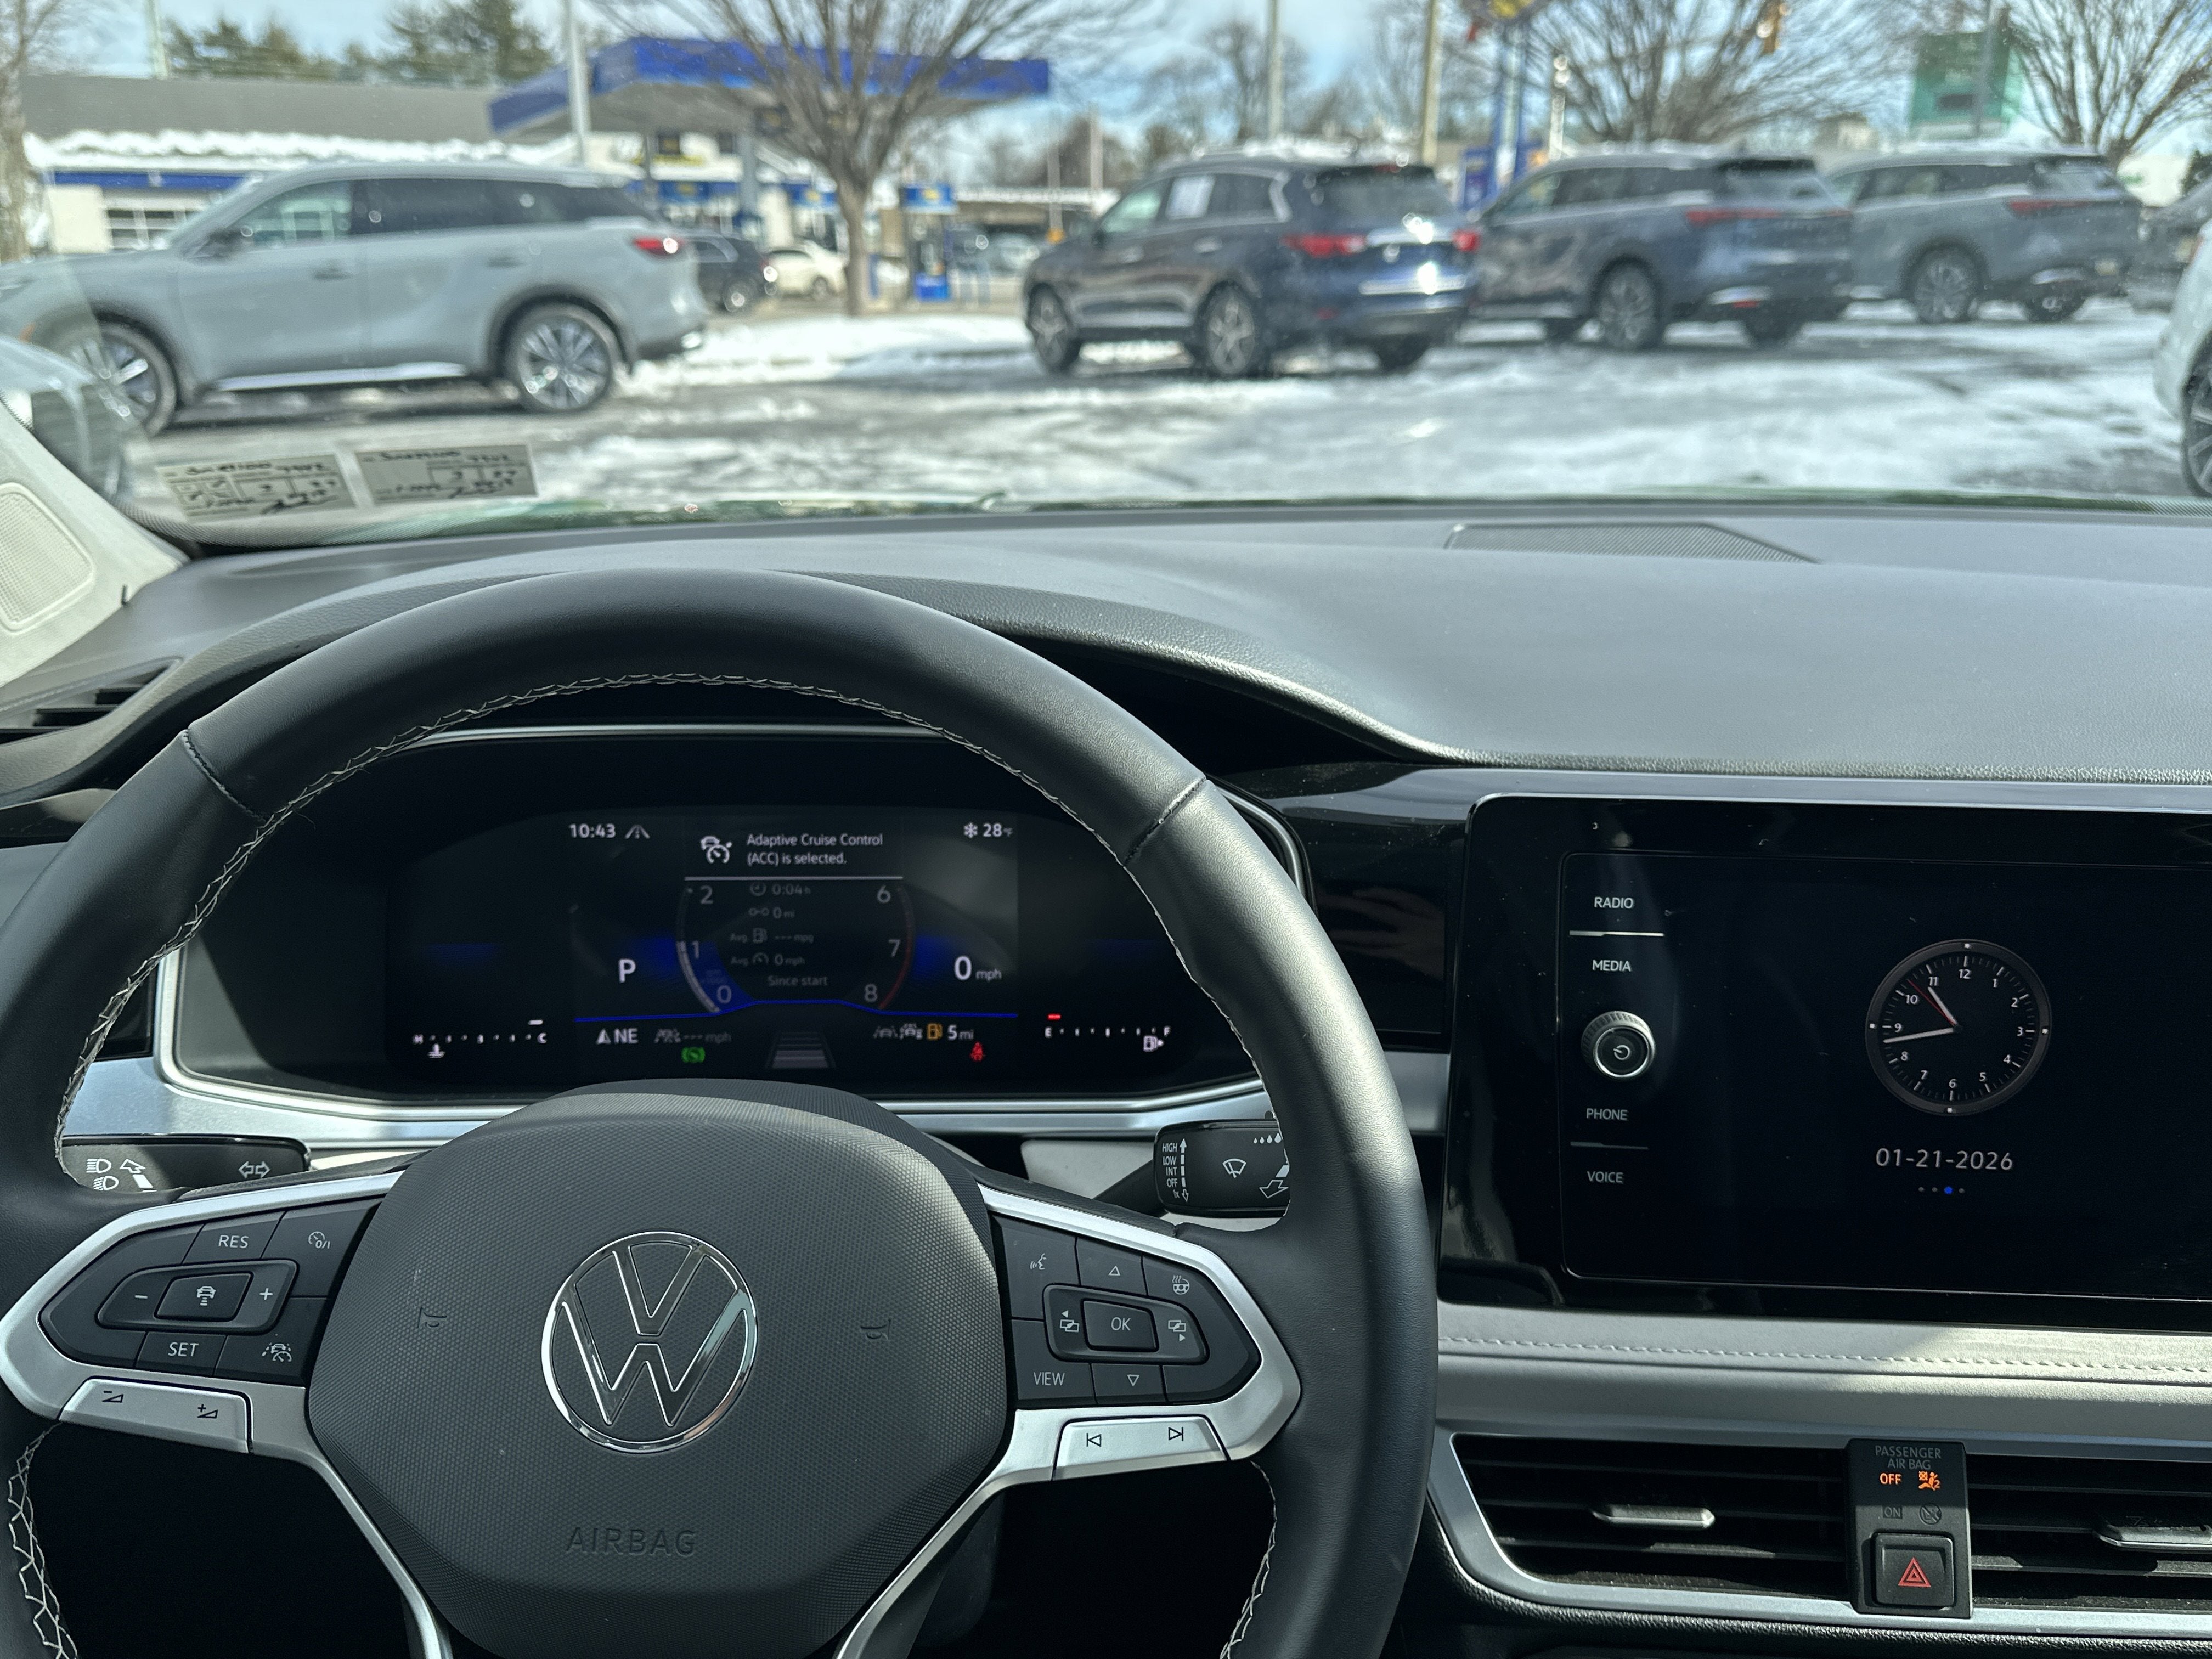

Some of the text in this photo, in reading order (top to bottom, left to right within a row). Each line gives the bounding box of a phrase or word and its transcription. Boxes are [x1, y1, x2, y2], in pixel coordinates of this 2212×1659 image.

[569, 823, 616, 838] 10:43
[747, 833, 883, 848] Adaptive Cruise Control
[747, 852, 847, 866] (ACC) is selected.
[700, 885, 713, 904] 2
[772, 884, 803, 895] 0:04
[877, 885, 891, 904] 6
[1594, 896, 1634, 909] RADIO
[772, 907, 782, 918] 0
[691, 940, 700, 959] 1
[888, 939, 901, 957] 7
[774, 953, 783, 966] 0
[1592, 960, 1632, 972] MEDIA
[619, 958, 636, 983] P
[955, 956, 1002, 981] 0 mph
[1959, 969, 1971, 979] 12
[768, 975, 827, 986] Since start
[1927, 976, 1939, 987] 11
[716, 986, 732, 1004] 0
[864, 984, 878, 1002] 8
[1905, 994, 1918, 1005] 10
[2011, 997, 2018, 1008] 2
[948, 1025, 974, 1040] 5 mi
[1044, 1026, 1053, 1038] E
[1163, 1026, 1171, 1037] F
[1894, 1023, 1902, 1033] 9
[2017, 1026, 2023, 1036] 3
[614, 1028, 637, 1043] NE
[1900, 1051, 1908, 1061] 8
[2003, 1054, 2011, 1064] 4
[1921, 1070, 1928, 1080] 7
[1979, 1071, 1986, 1082] 5
[1949, 1078, 1956, 1088] 6
[1586, 1108, 1628, 1121] PHONE
[1162, 1142, 1178, 1153] HIGH
[1163, 1155, 1177, 1166] LOW
[1876, 1148, 2013, 1171] 01-21-2026
[1166, 1166, 1177, 1176] INT
[1587, 1171, 1623, 1183] VOICE
[1166, 1178, 1178, 1188] OFF
[218, 1234, 249, 1249] RES
[1111, 1317, 1131, 1331] OK
[168, 1341, 199, 1357] SET
[1033, 1372, 1065, 1386] VIEW
[1875, 1444, 1942, 1459] PASSENGER
[1887, 1458, 1932, 1470] AIR BAG
[1880, 1472, 1901, 1485] OFF
[1883, 1505, 1902, 1518] ON
[566, 1527, 696, 1555] AIRBAG
